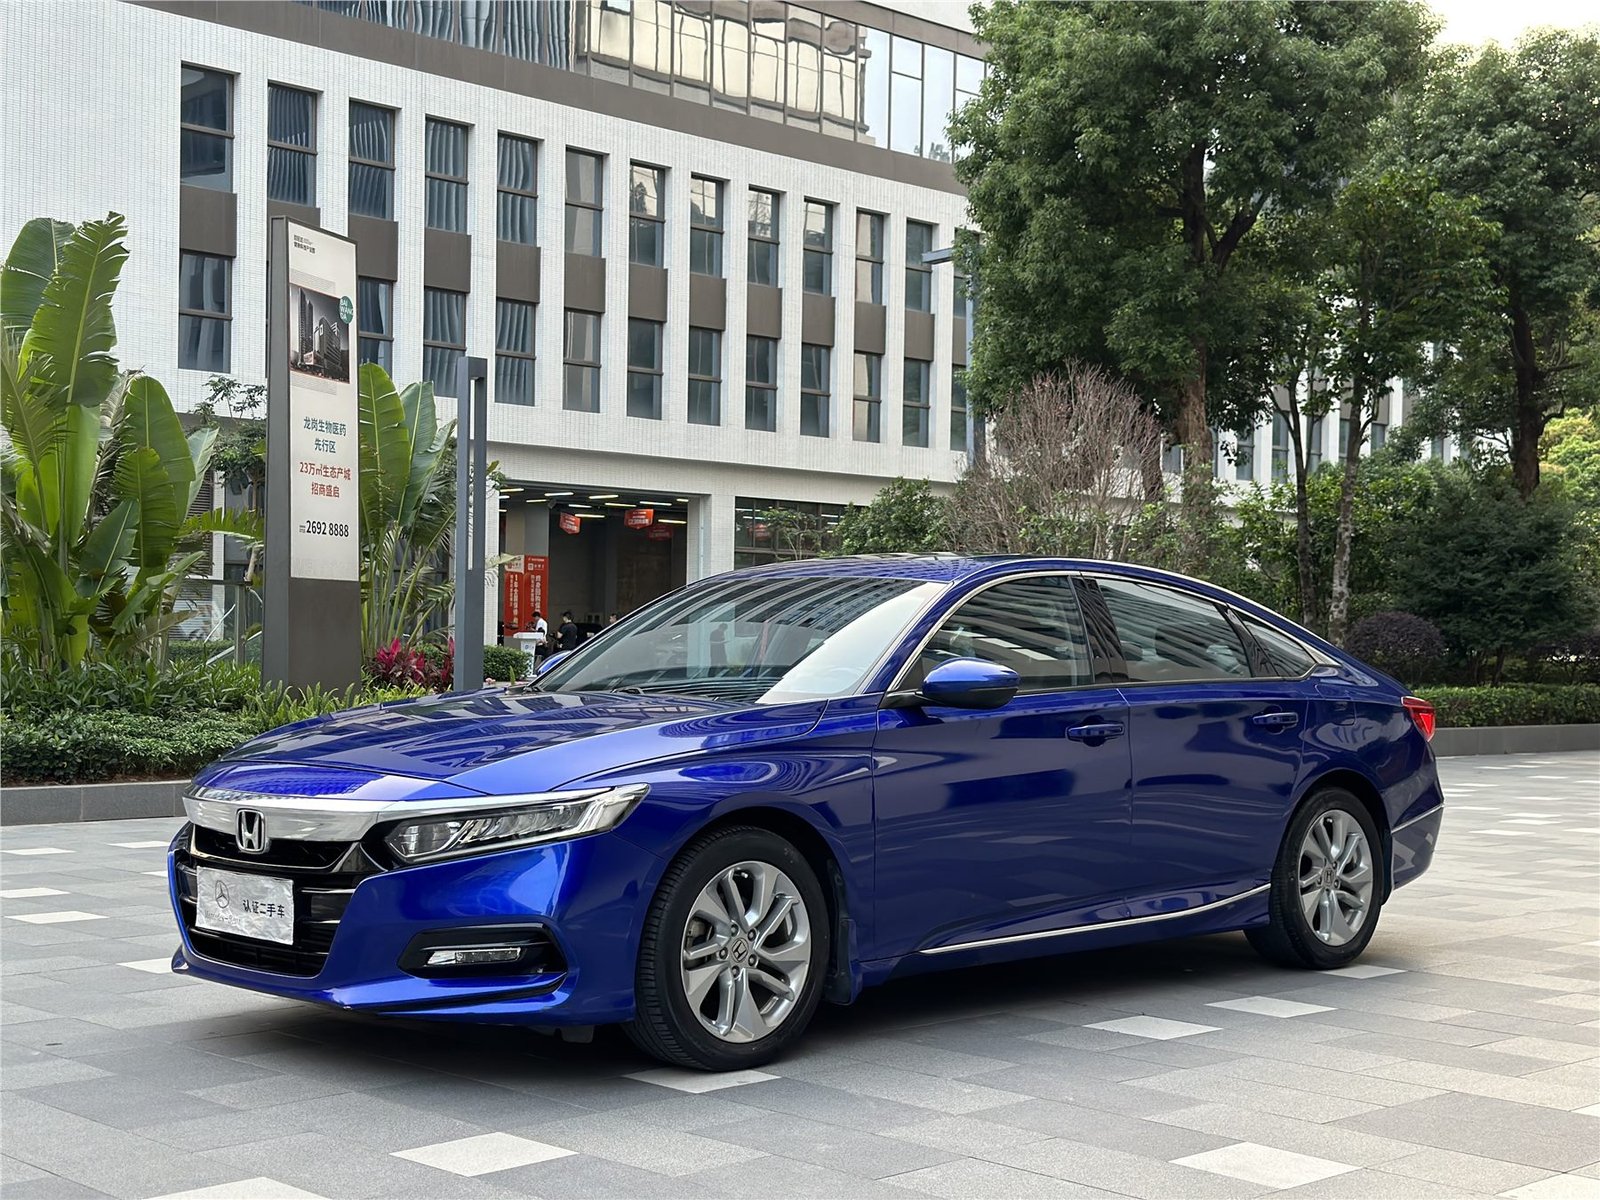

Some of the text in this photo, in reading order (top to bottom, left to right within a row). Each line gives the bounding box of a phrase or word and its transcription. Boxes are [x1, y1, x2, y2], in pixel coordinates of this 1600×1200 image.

[303, 416, 347, 437] 龙岗生物医药
[314, 437, 336, 454] 先行区
[311, 481, 340, 498] 招商盛启
[306, 519, 327, 535] 2692
[328, 522, 349, 538] 8888
[242, 899, 286, 919] 认证二手车
